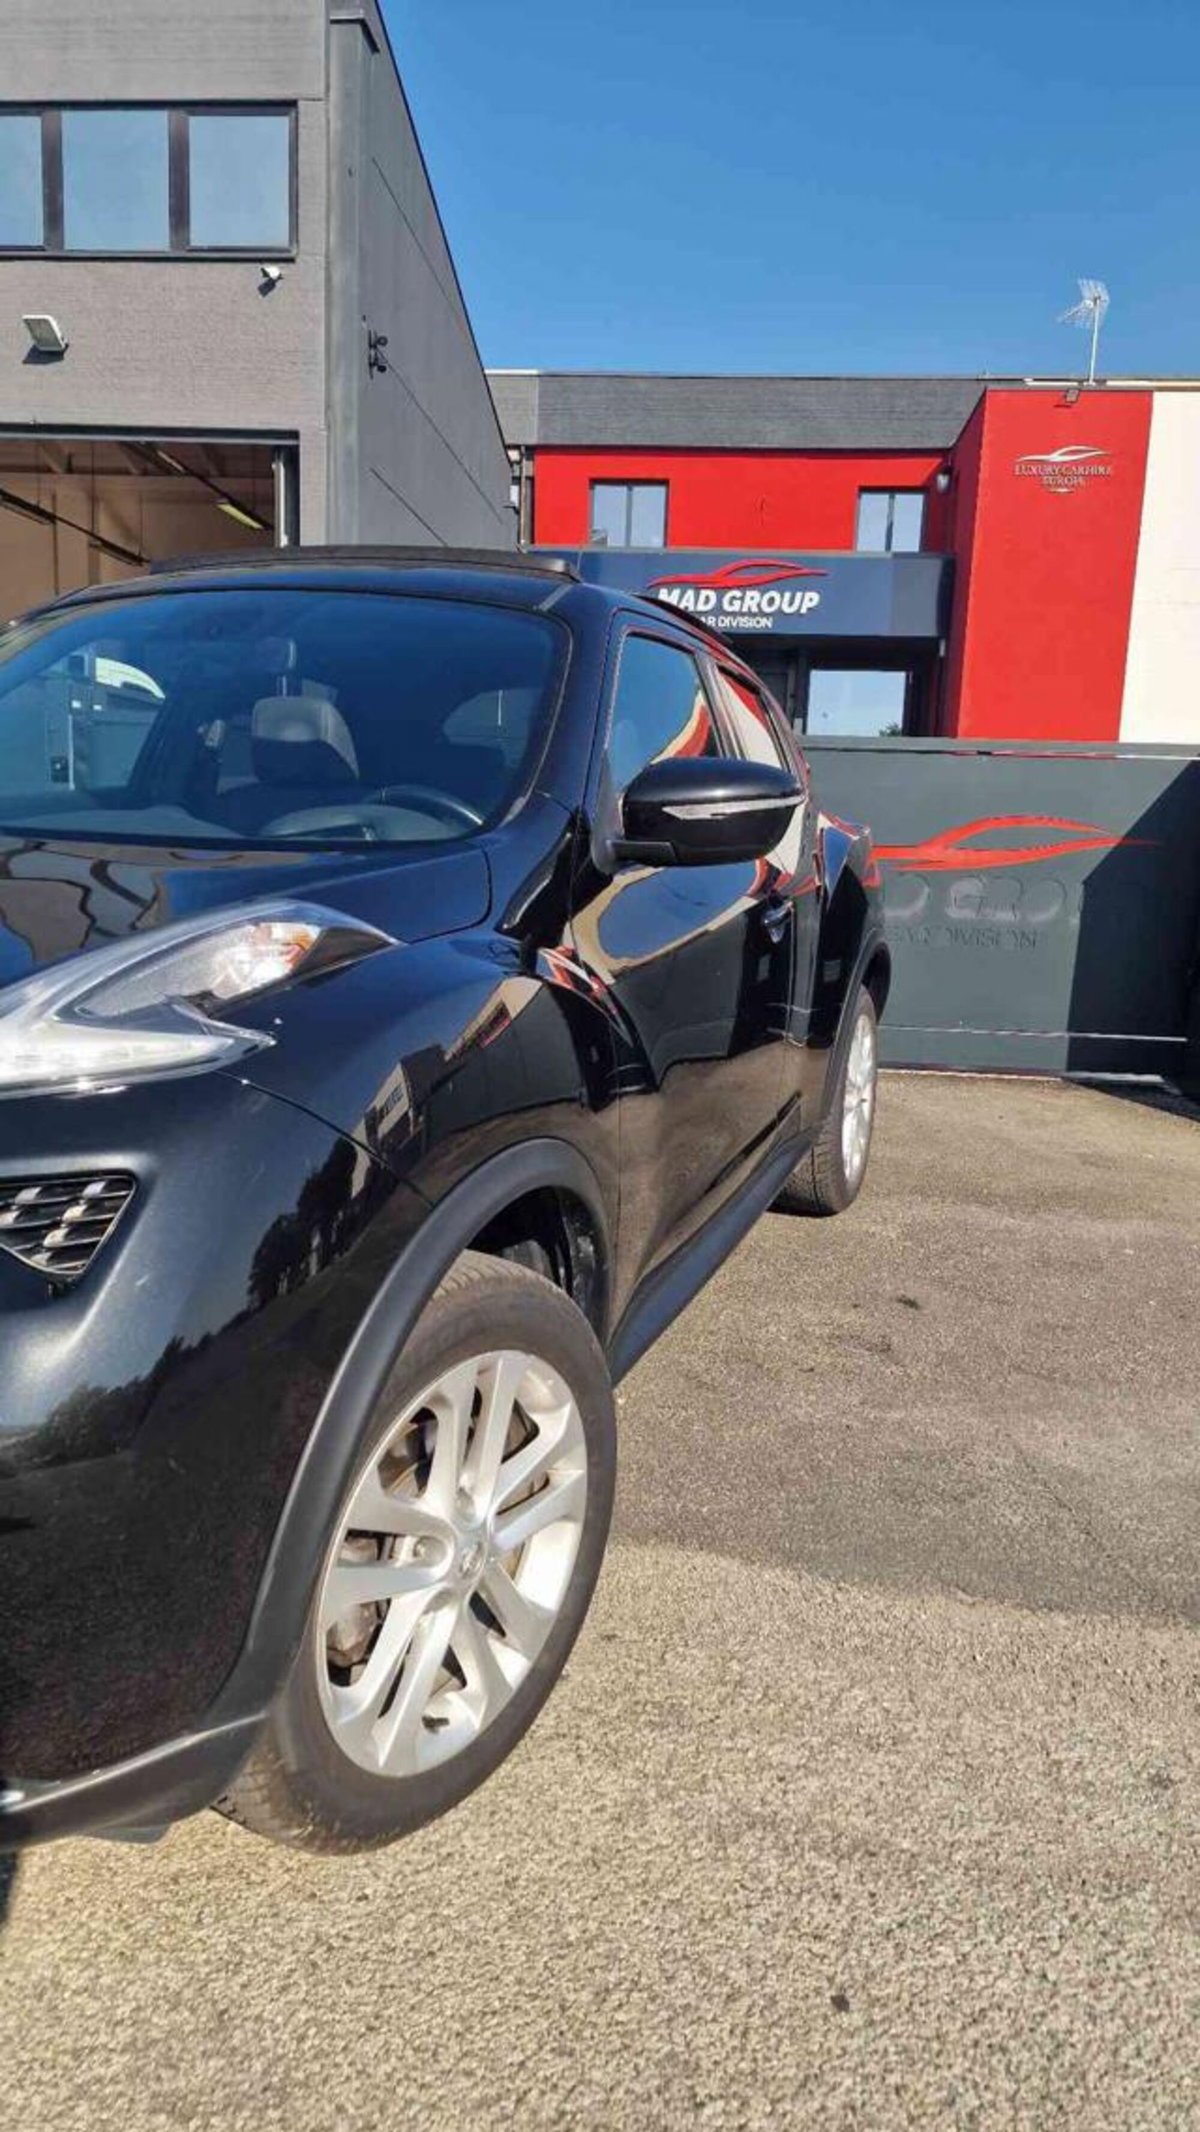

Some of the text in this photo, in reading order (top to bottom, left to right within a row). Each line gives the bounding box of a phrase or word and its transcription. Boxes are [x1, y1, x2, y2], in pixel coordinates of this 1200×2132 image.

[1014, 465, 1060, 476] LUXURY
[658, 588, 821, 614] MAD GROUP
[700, 615, 774, 629] AR DIVISION
